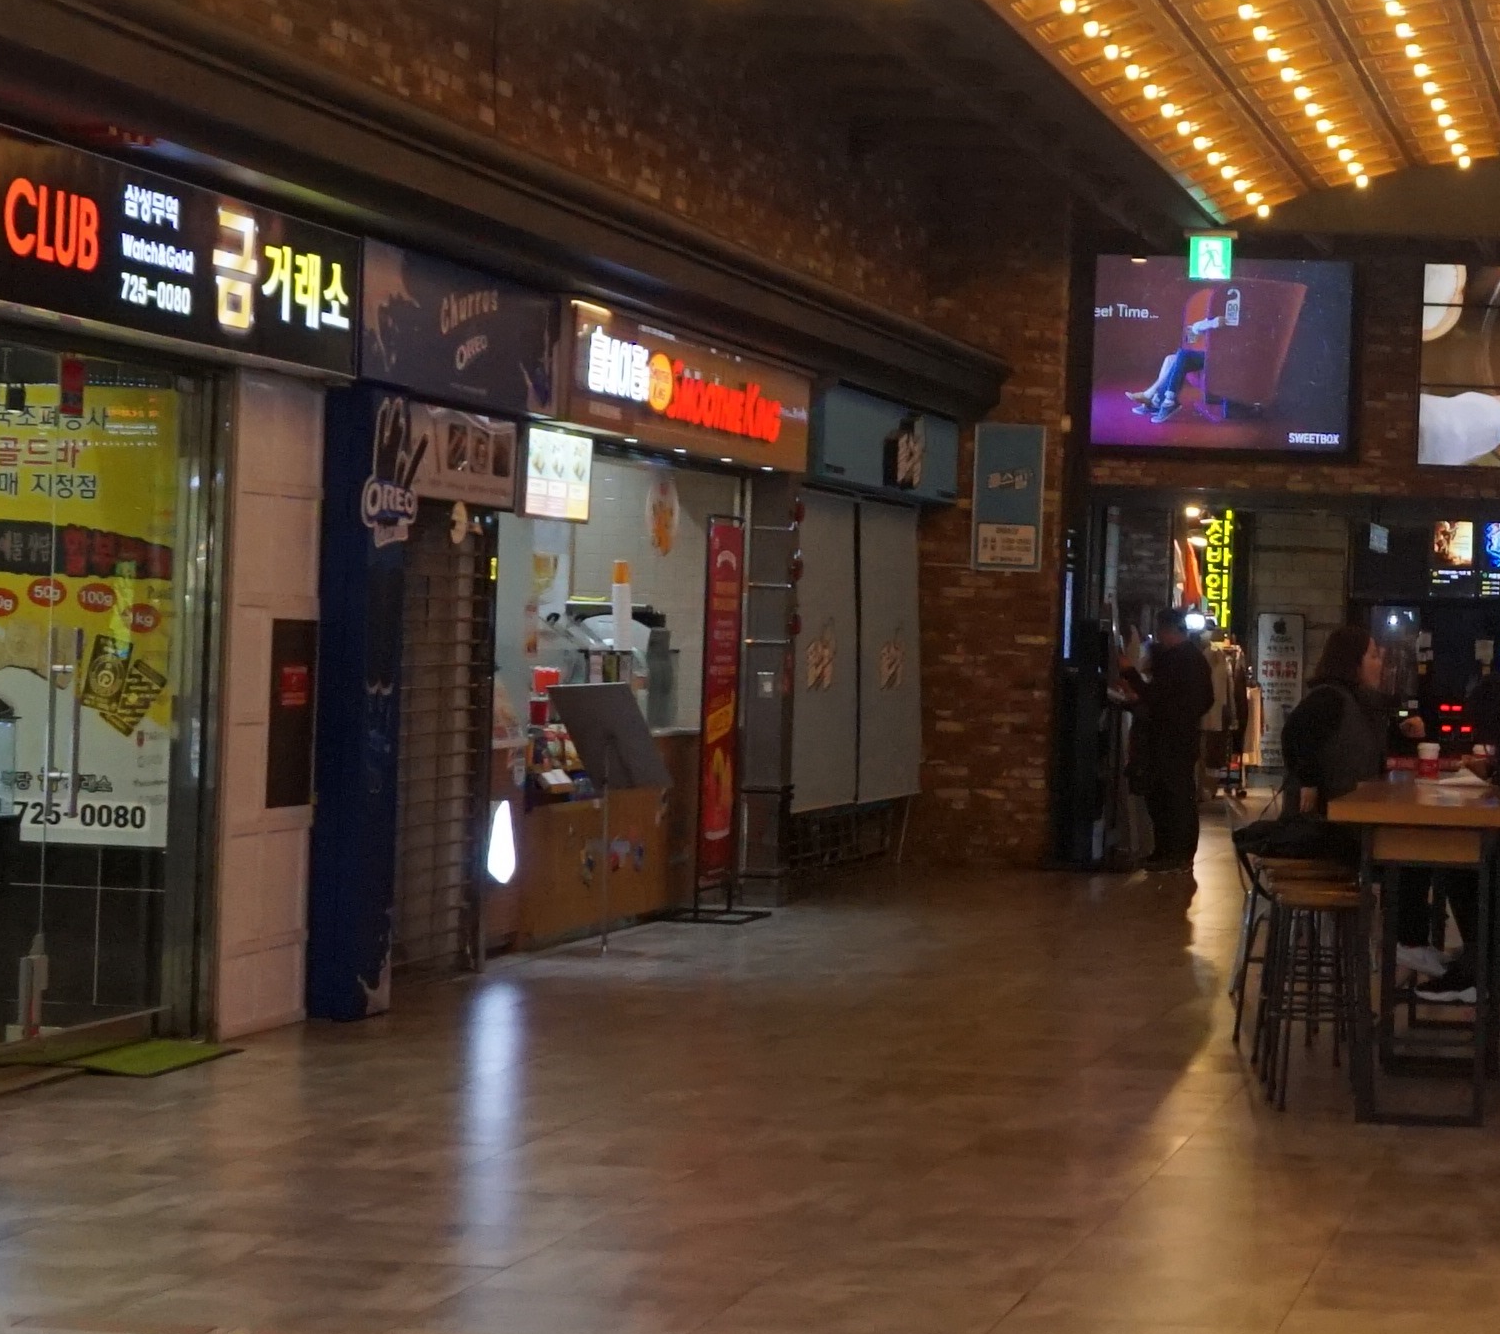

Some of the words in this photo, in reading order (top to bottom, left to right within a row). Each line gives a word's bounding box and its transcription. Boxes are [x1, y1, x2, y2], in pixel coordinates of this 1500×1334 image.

[3, 176, 99, 272] CLUB
[122, 184, 181, 231] 삼성무역
[120, 232, 195, 275] Watch&Gold
[120, 271, 192, 317] 725-0080
[440, 288, 500, 336] Churros
[1288, 432, 1340, 445] SWEETBOX
[30, 473, 97, 500] 지정점
[362, 482, 416, 516] OREO
[13, 800, 147, 830] 725-0080
